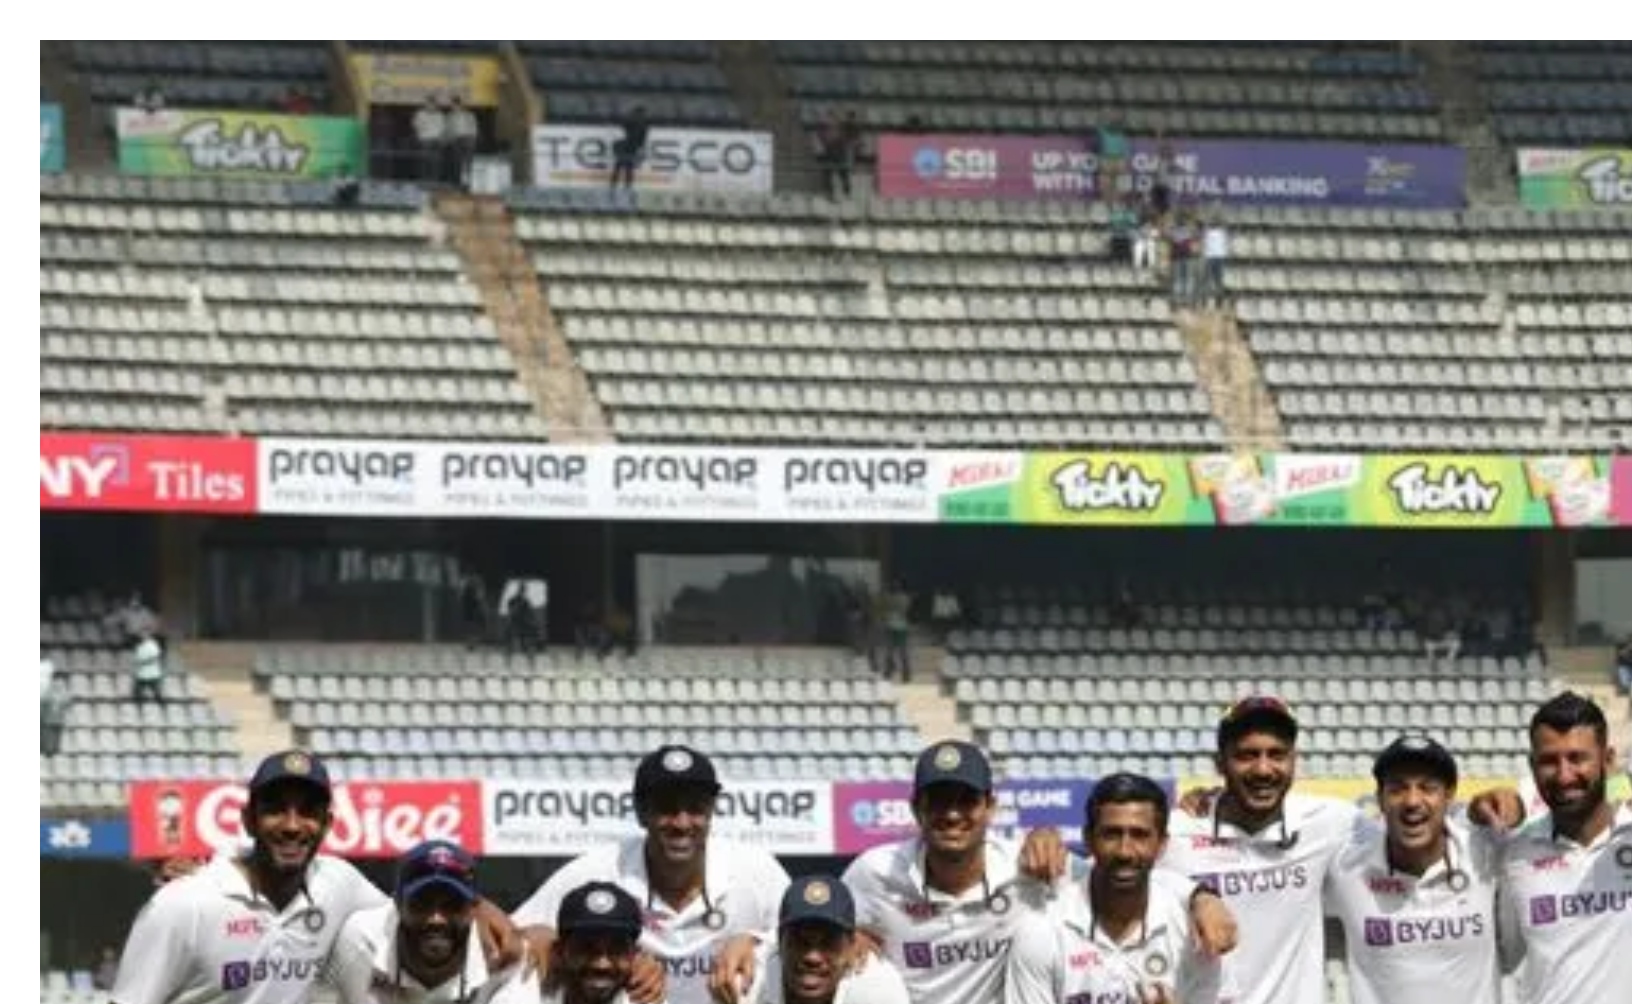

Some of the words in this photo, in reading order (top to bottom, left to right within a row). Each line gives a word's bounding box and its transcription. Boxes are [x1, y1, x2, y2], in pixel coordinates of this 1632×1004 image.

[944, 148, 998, 181] SBI
[146, 460, 245, 501] Tiles
[1224, 865, 1308, 896] BYJU'S
[1397, 913, 1484, 944] BYJU'S
